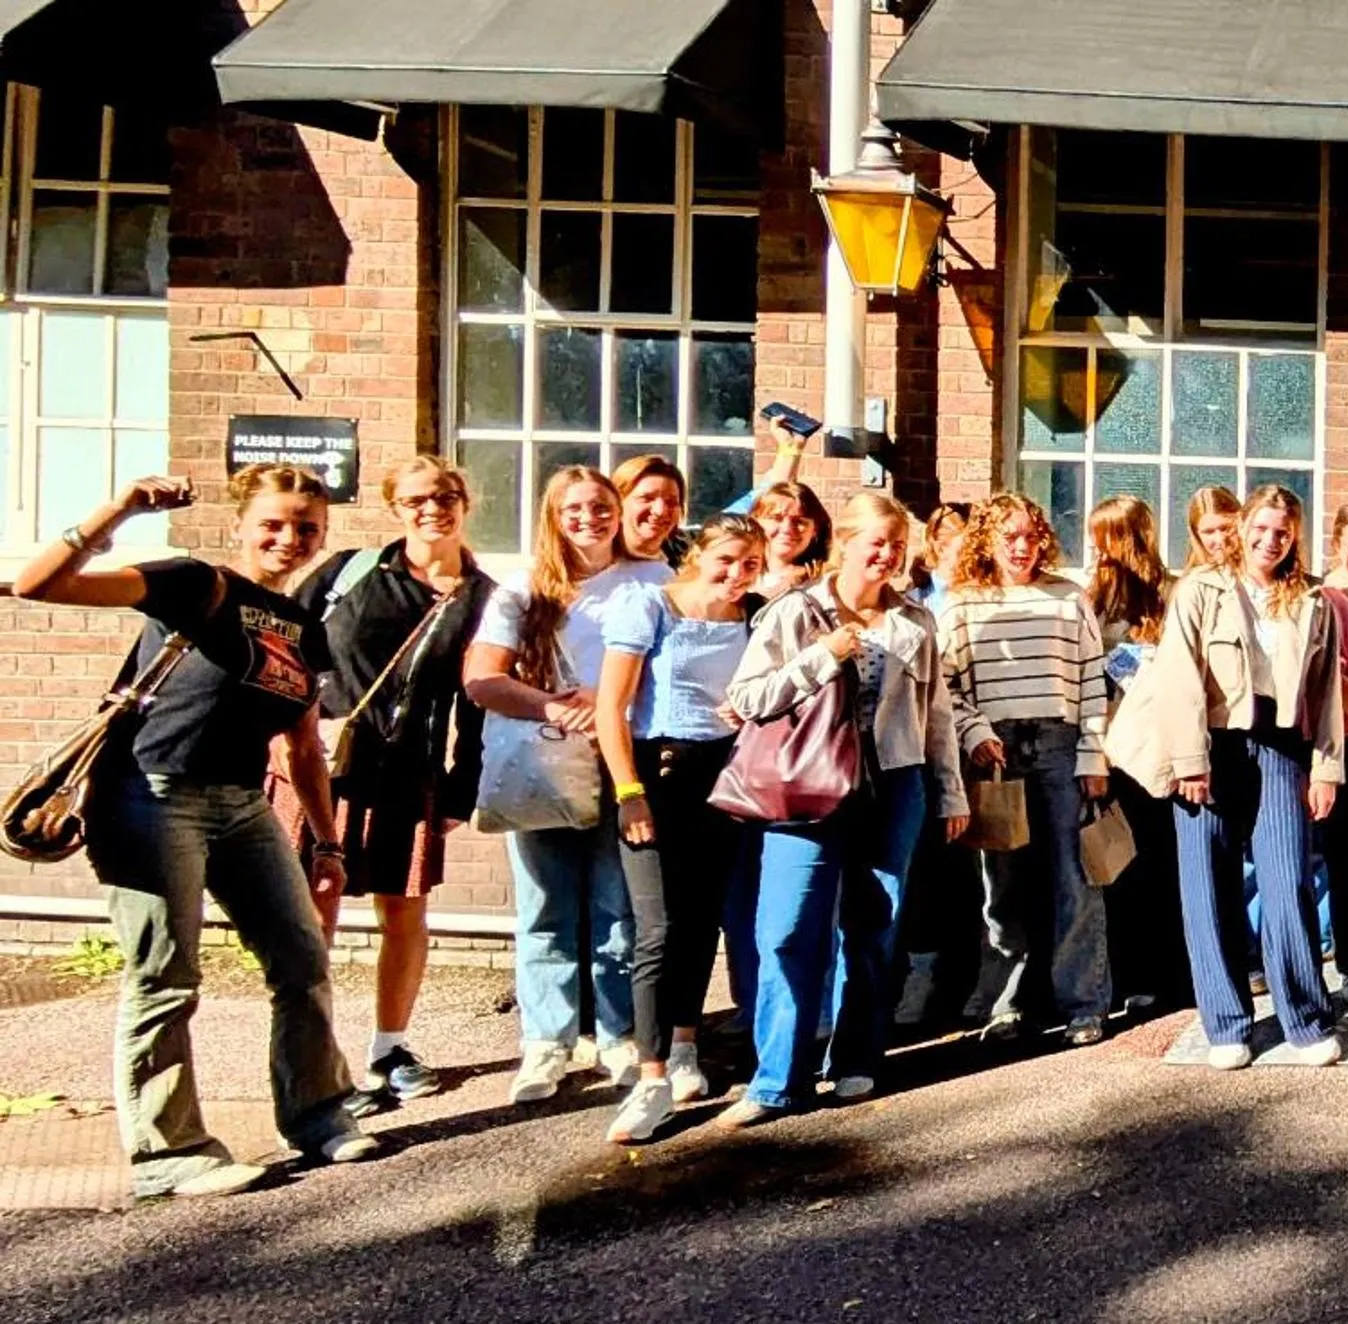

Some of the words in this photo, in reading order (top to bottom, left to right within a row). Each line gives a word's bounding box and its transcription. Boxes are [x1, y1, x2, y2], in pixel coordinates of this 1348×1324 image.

[234, 435, 283, 448] PLEASE
[286, 436, 322, 448] KEEP
[324, 438, 353, 450] THE
[233, 451, 276, 462] NOISE
